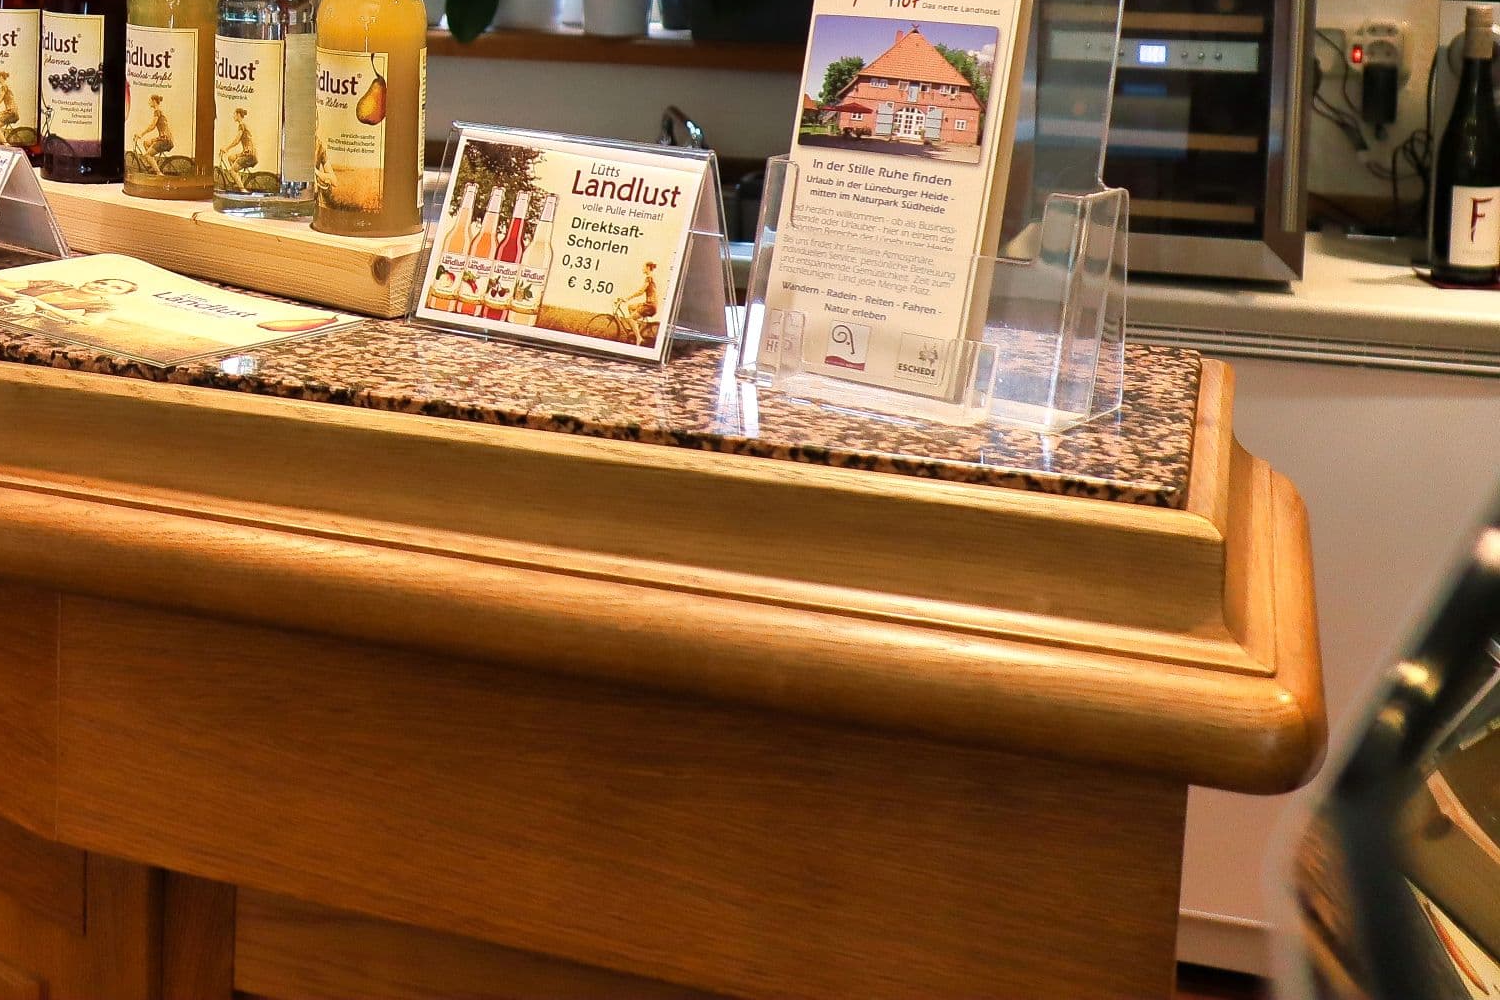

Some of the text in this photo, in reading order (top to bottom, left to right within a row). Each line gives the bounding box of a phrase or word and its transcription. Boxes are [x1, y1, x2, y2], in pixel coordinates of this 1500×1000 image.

[922, 2, 1001, 16] Das nette Landhotel
[43, 31, 79, 54] dlust
[126, 46, 172, 69] ndlust
[217, 56, 257, 81] dlust
[318, 70, 359, 96] dlust
[590, 162, 620, 178] Lütts
[812, 158, 952, 186] In der Stille Ruhe finden
[572, 169, 681, 208] Landlust
[806, 174, 833, 186] Urlaub
[836, 179, 844, 187] in
[847, 180, 862, 190] der
[864, 182, 918, 198] Lüneburger
[920, 190, 949, 202] Heide
[582, 203, 664, 221] volle Pulle Heimat!
[810, 188, 946, 214] mitten im Naturpark Südheide
[571, 216, 644, 238] Direktsaft-
[1470, 196, 1494, 243] F
[566, 234, 629, 255] Schorlen
[562, 254, 592, 270] 0,33
[568, 275, 614, 294] € 3,50
[152, 291, 258, 318] Landlust
[782, 281, 819, 295] Wandern
[826, 289, 857, 301] Radeln
[865, 295, 894, 308] Reiten
[902, 302, 936, 315] Fahren
[824, 303, 887, 321] Natur erleben
